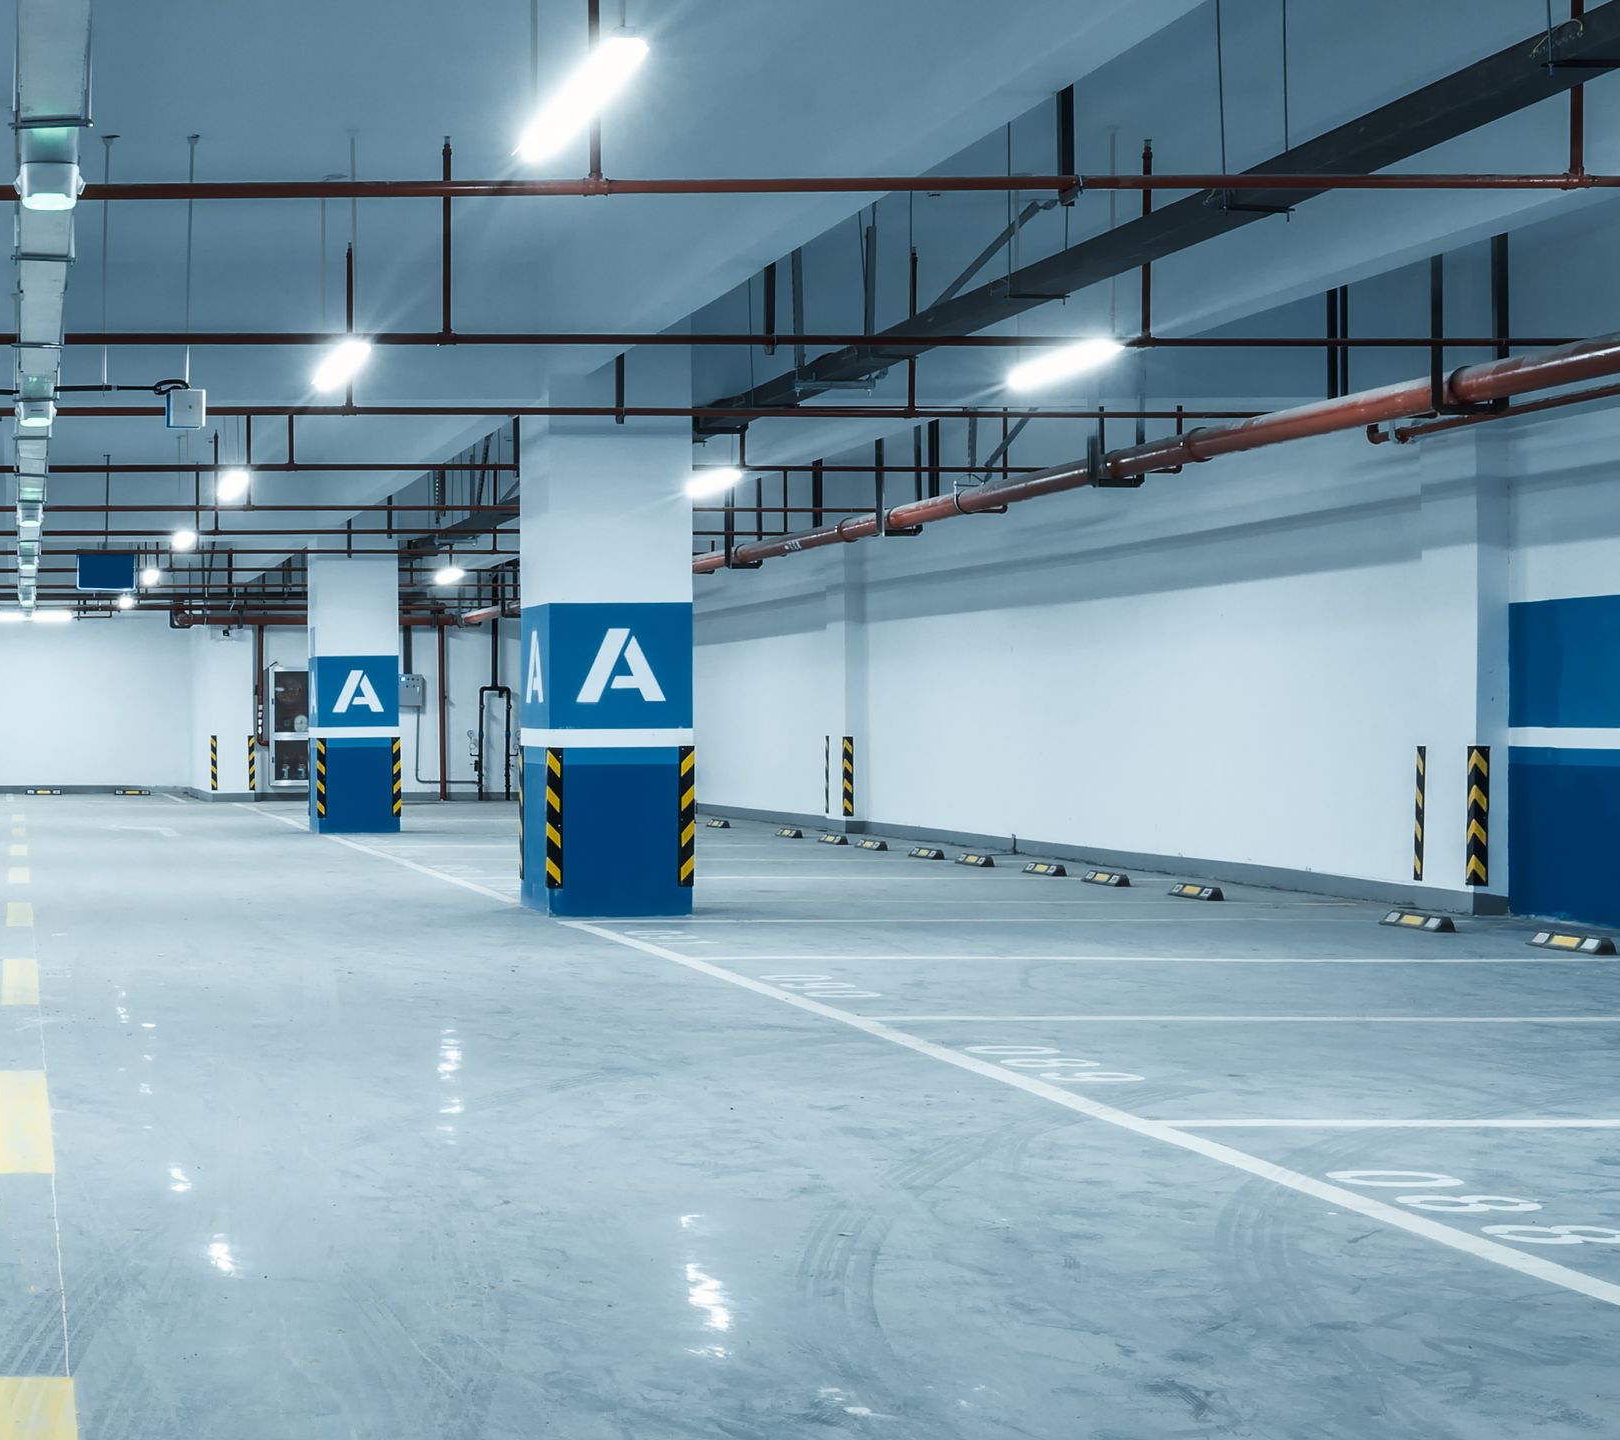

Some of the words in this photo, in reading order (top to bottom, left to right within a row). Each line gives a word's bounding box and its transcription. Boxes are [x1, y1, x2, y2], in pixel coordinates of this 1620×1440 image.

[525, 630, 544, 703] A
[576, 628, 667, 703] A
[332, 670, 384, 713] A
[758, 974, 883, 998] 090
[964, 1045, 1146, 1082] 089
